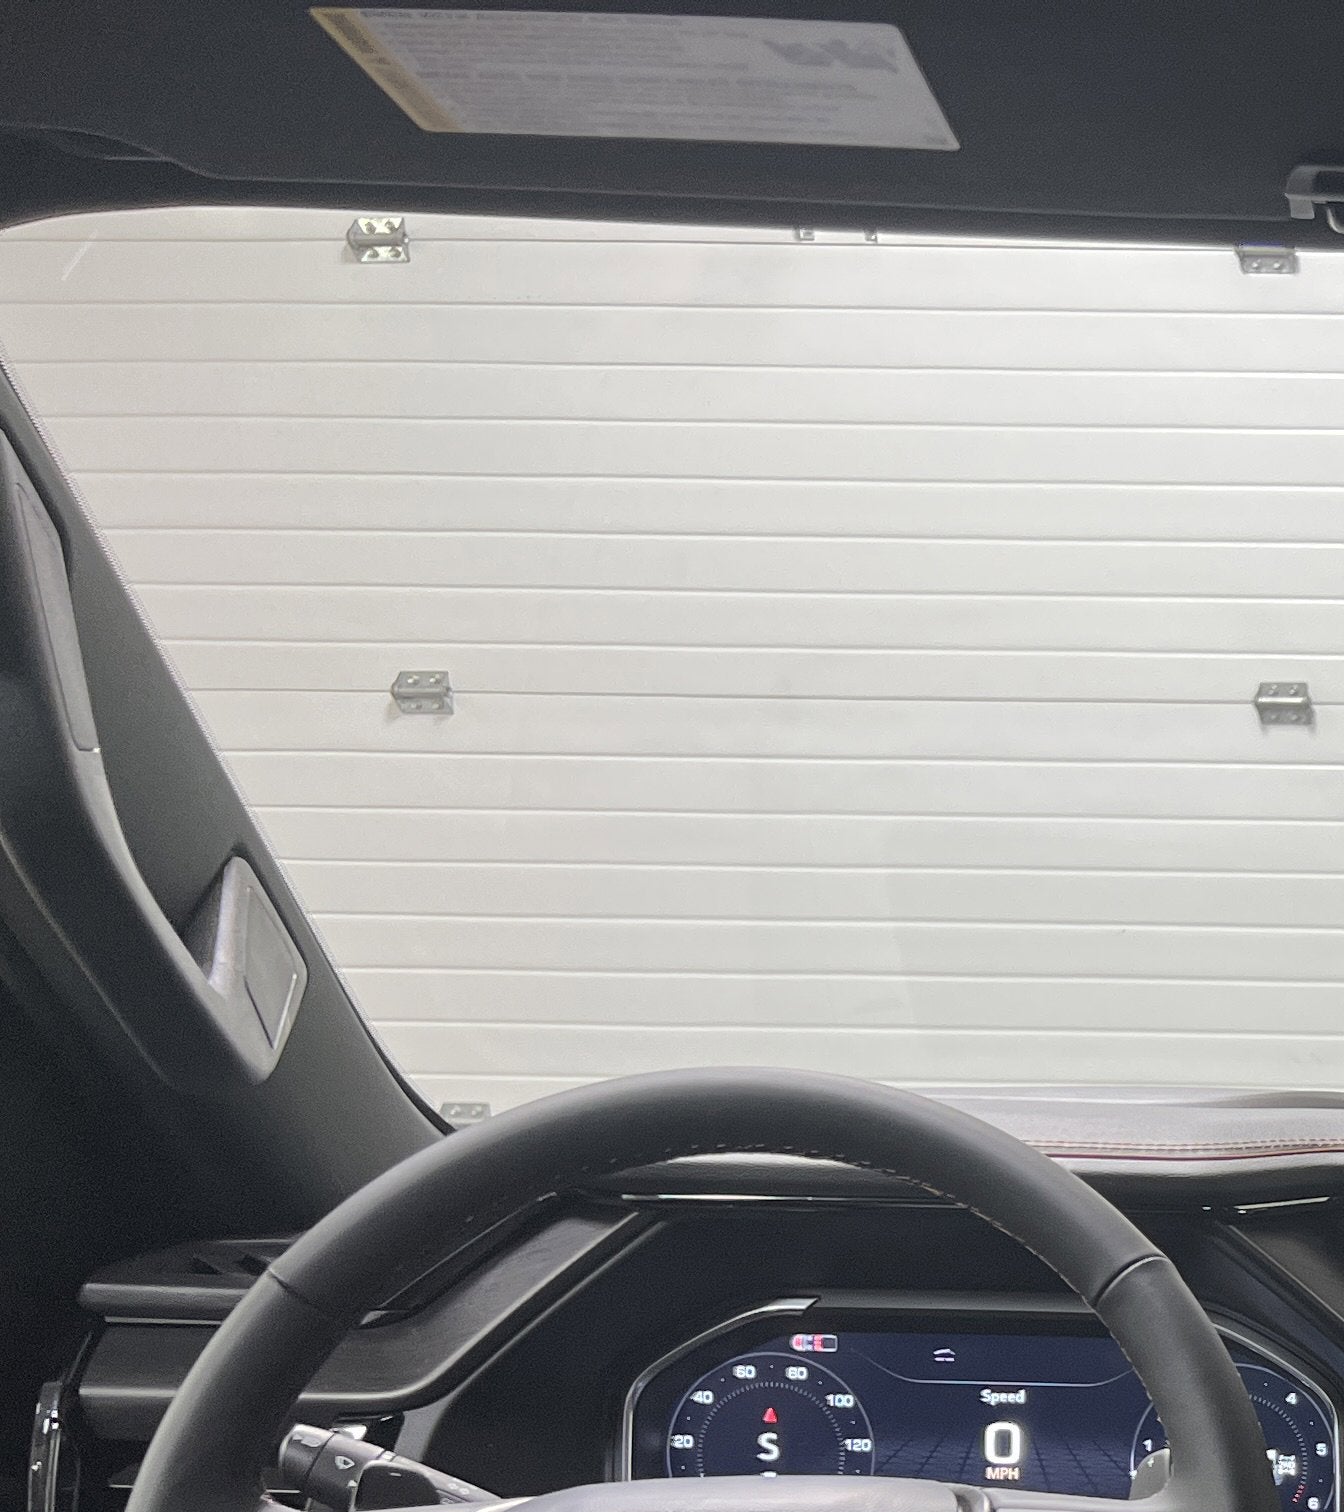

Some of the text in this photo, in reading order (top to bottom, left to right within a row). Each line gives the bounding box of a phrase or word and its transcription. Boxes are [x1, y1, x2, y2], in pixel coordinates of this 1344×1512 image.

[733, 1364, 757, 1380] 60
[784, 1365, 809, 1381] 80
[690, 1389, 714, 1405] 40
[825, 1393, 857, 1408] 100
[980, 1388, 1026, 1406] Speed
[1285, 1392, 1297, 1405] 4
[671, 1433, 695, 1449] 20
[757, 1431, 781, 1462] S
[842, 1437, 872, 1453] 120
[984, 1420, 1021, 1465] 0
[1315, 1442, 1328, 1457] 5
[985, 1466, 1020, 1480] MPH
